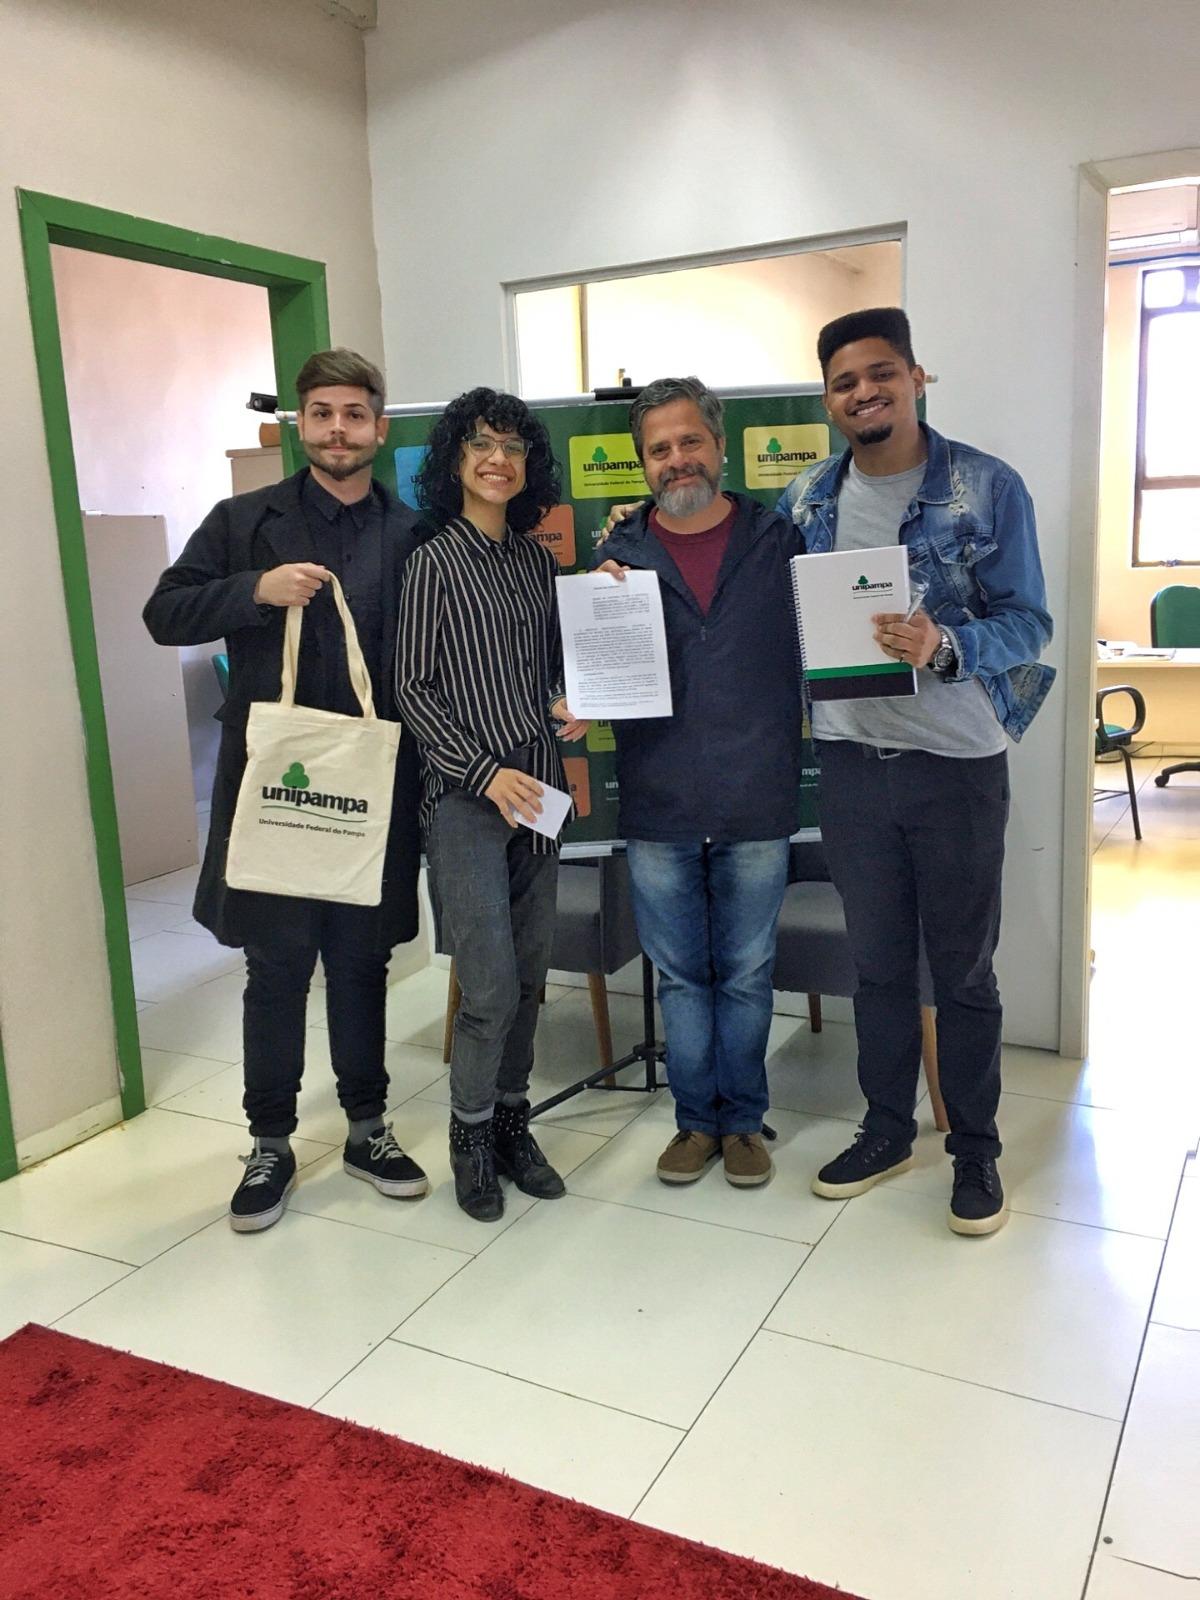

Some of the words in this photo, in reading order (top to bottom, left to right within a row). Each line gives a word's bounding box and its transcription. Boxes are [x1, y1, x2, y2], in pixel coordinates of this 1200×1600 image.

[757, 451, 817, 463] unipampa
[583, 460, 644, 472] unipampa
[852, 582, 893, 591] unipampa
[262, 786, 368, 813] unipampa
[258, 818, 304, 829] Universidade
[305, 824, 332, 833] Federal
[332, 827, 342, 835] do
